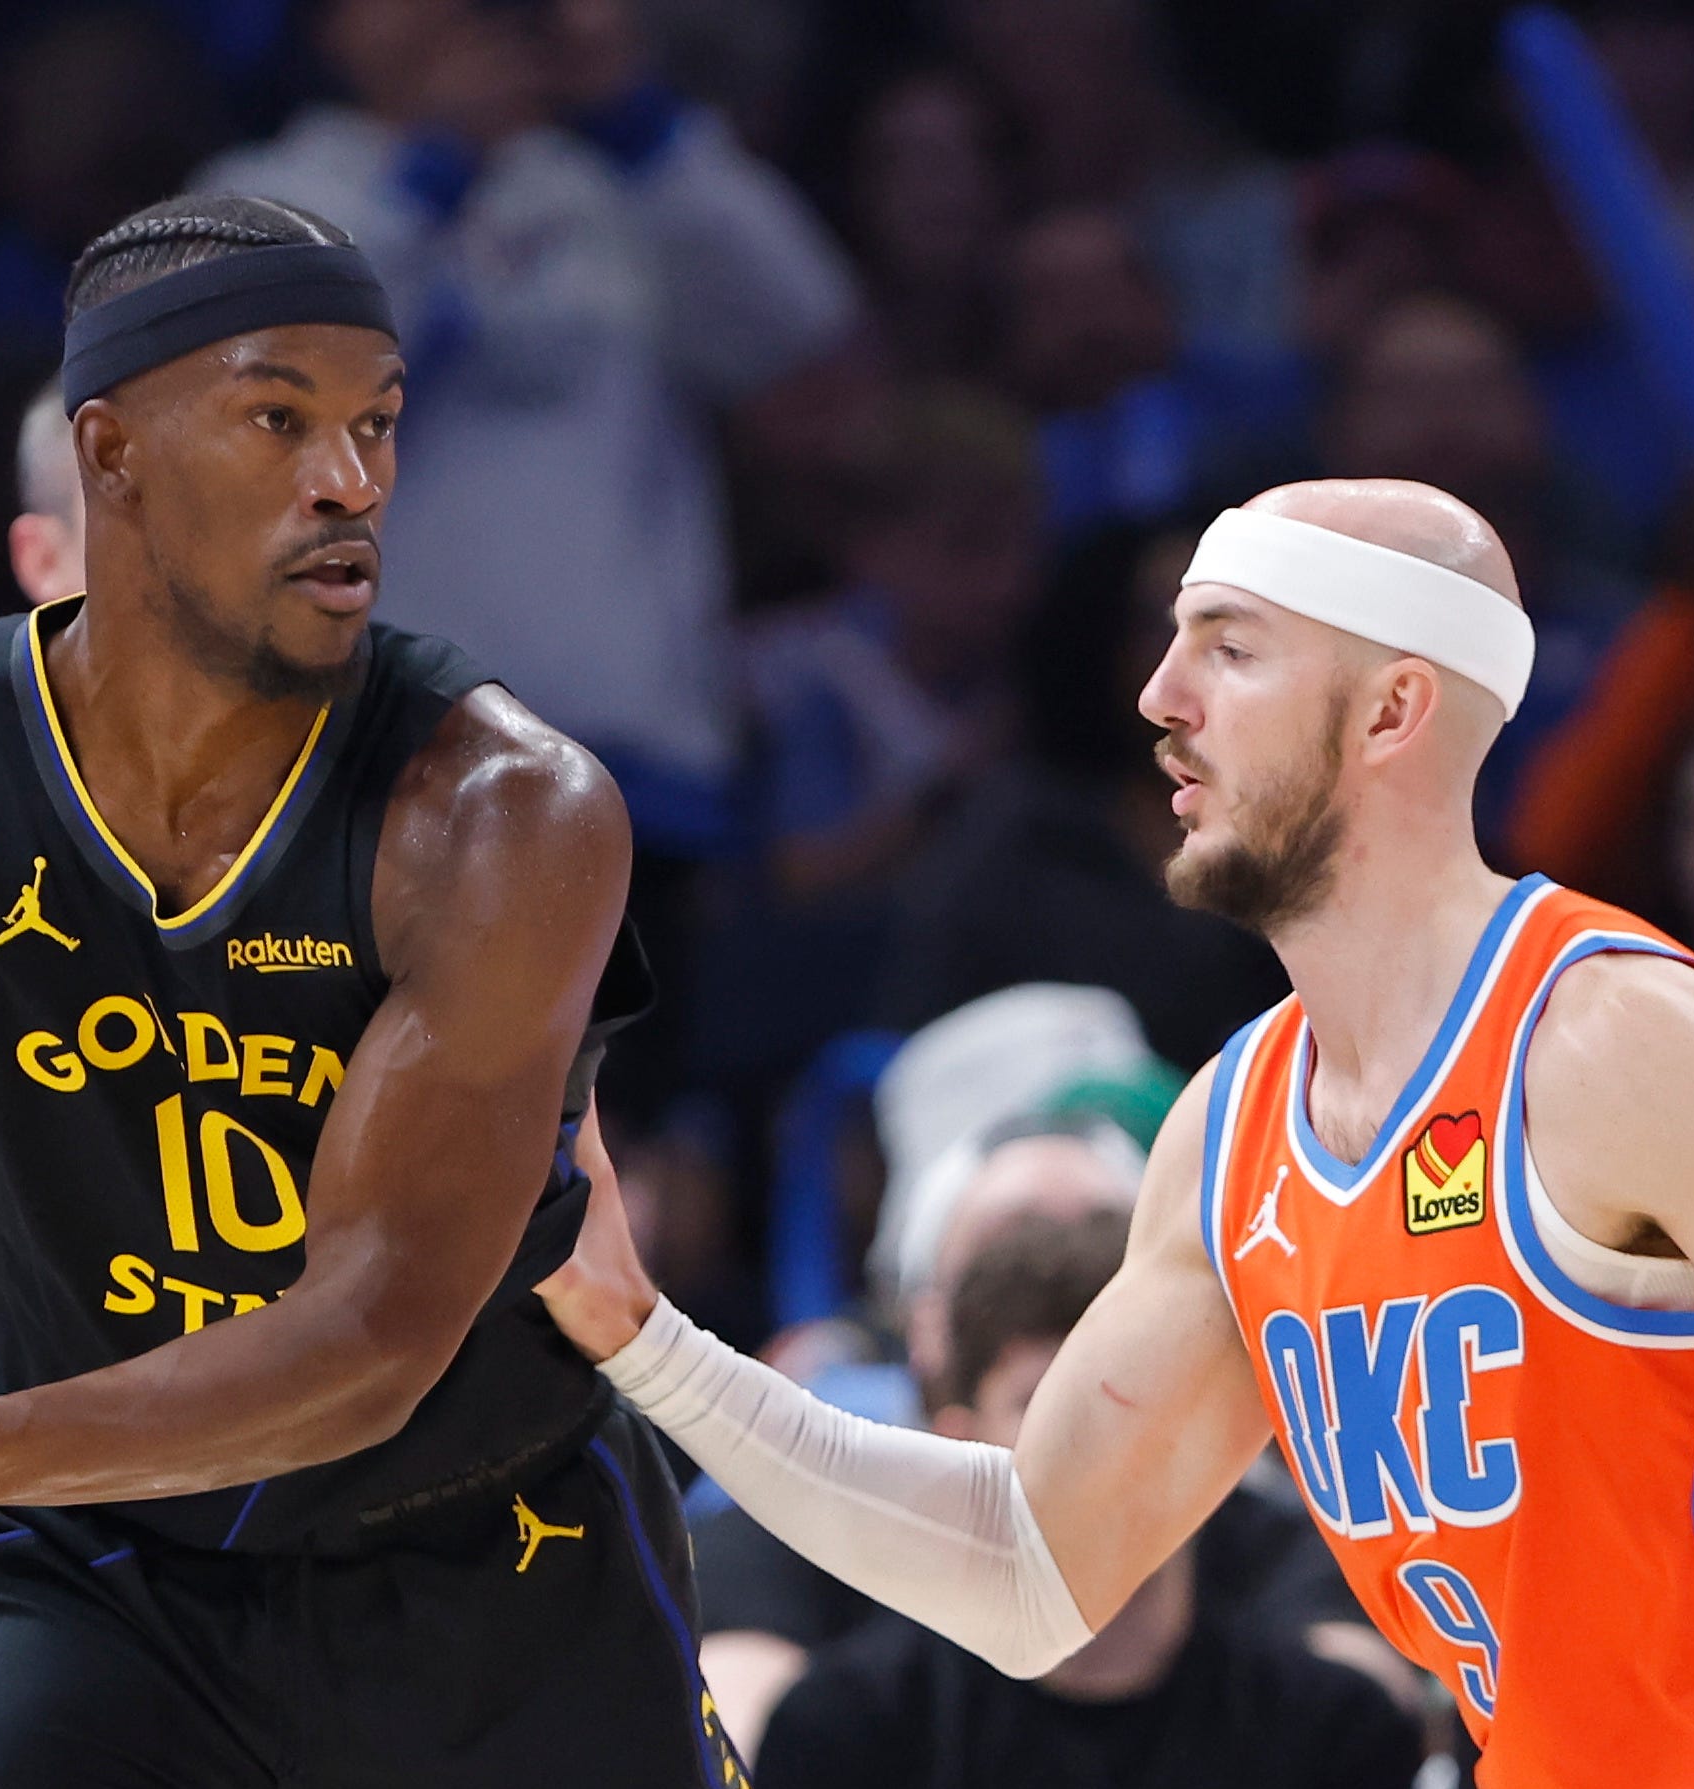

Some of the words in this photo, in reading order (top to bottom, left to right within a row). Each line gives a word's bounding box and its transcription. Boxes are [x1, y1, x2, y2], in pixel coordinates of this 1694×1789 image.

[227, 932, 353, 970] Rakuten
[16, 993, 346, 1108] GODEN
[155, 1093, 306, 1252] 10
[1260, 1284, 1523, 1540] OKC
[1397, 1559, 1501, 1721] 9
